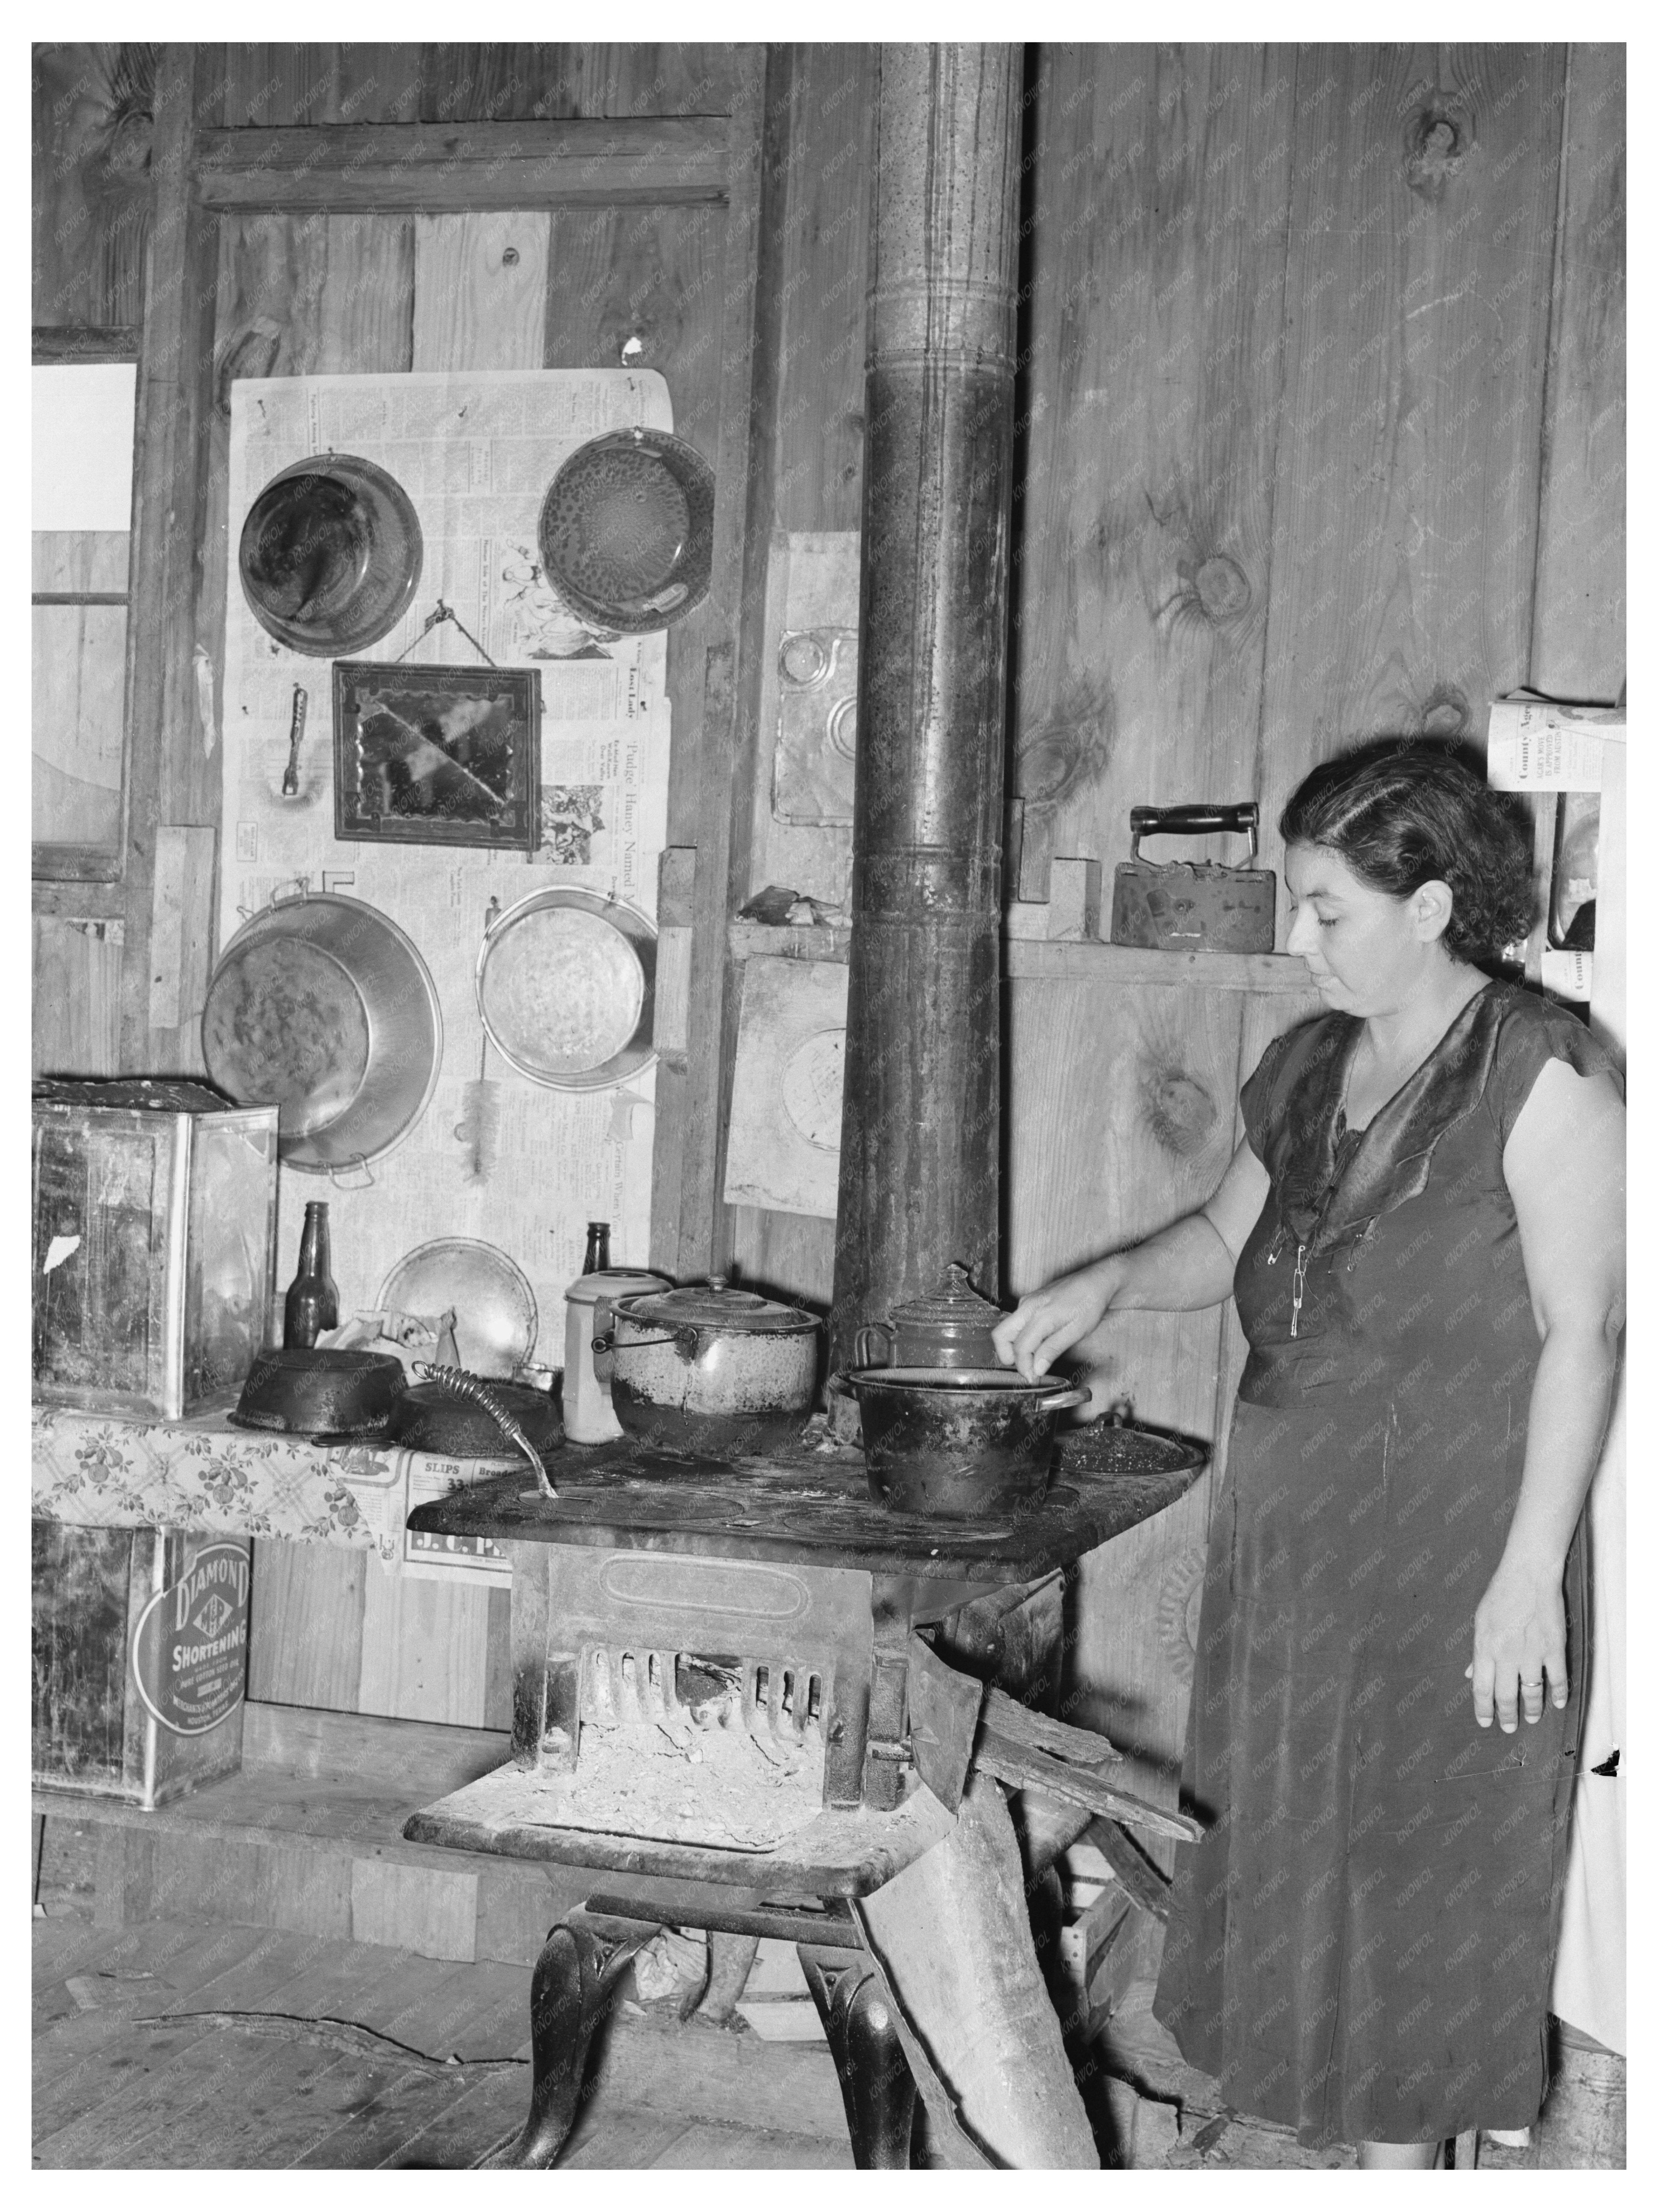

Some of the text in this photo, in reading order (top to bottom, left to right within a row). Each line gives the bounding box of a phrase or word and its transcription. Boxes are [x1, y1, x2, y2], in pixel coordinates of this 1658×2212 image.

[625, 667, 637, 719] Lost Lady
[1517, 735, 1532, 780] County
[623, 793, 636, 834] Haney
[624, 841, 636, 887] Named
[1574, 952, 1584, 990] Count
[613, 1182, 623, 1209] When
[425, 1462, 460, 1474] SLIPS
[175, 1558, 249, 1631] DIAMOND
[172, 1625, 246, 1672] SHORTENING
[196, 1669, 216, 1683] COTTON
[216, 1663, 229, 1673] SEED
[230, 1658, 239, 1669] OIL
